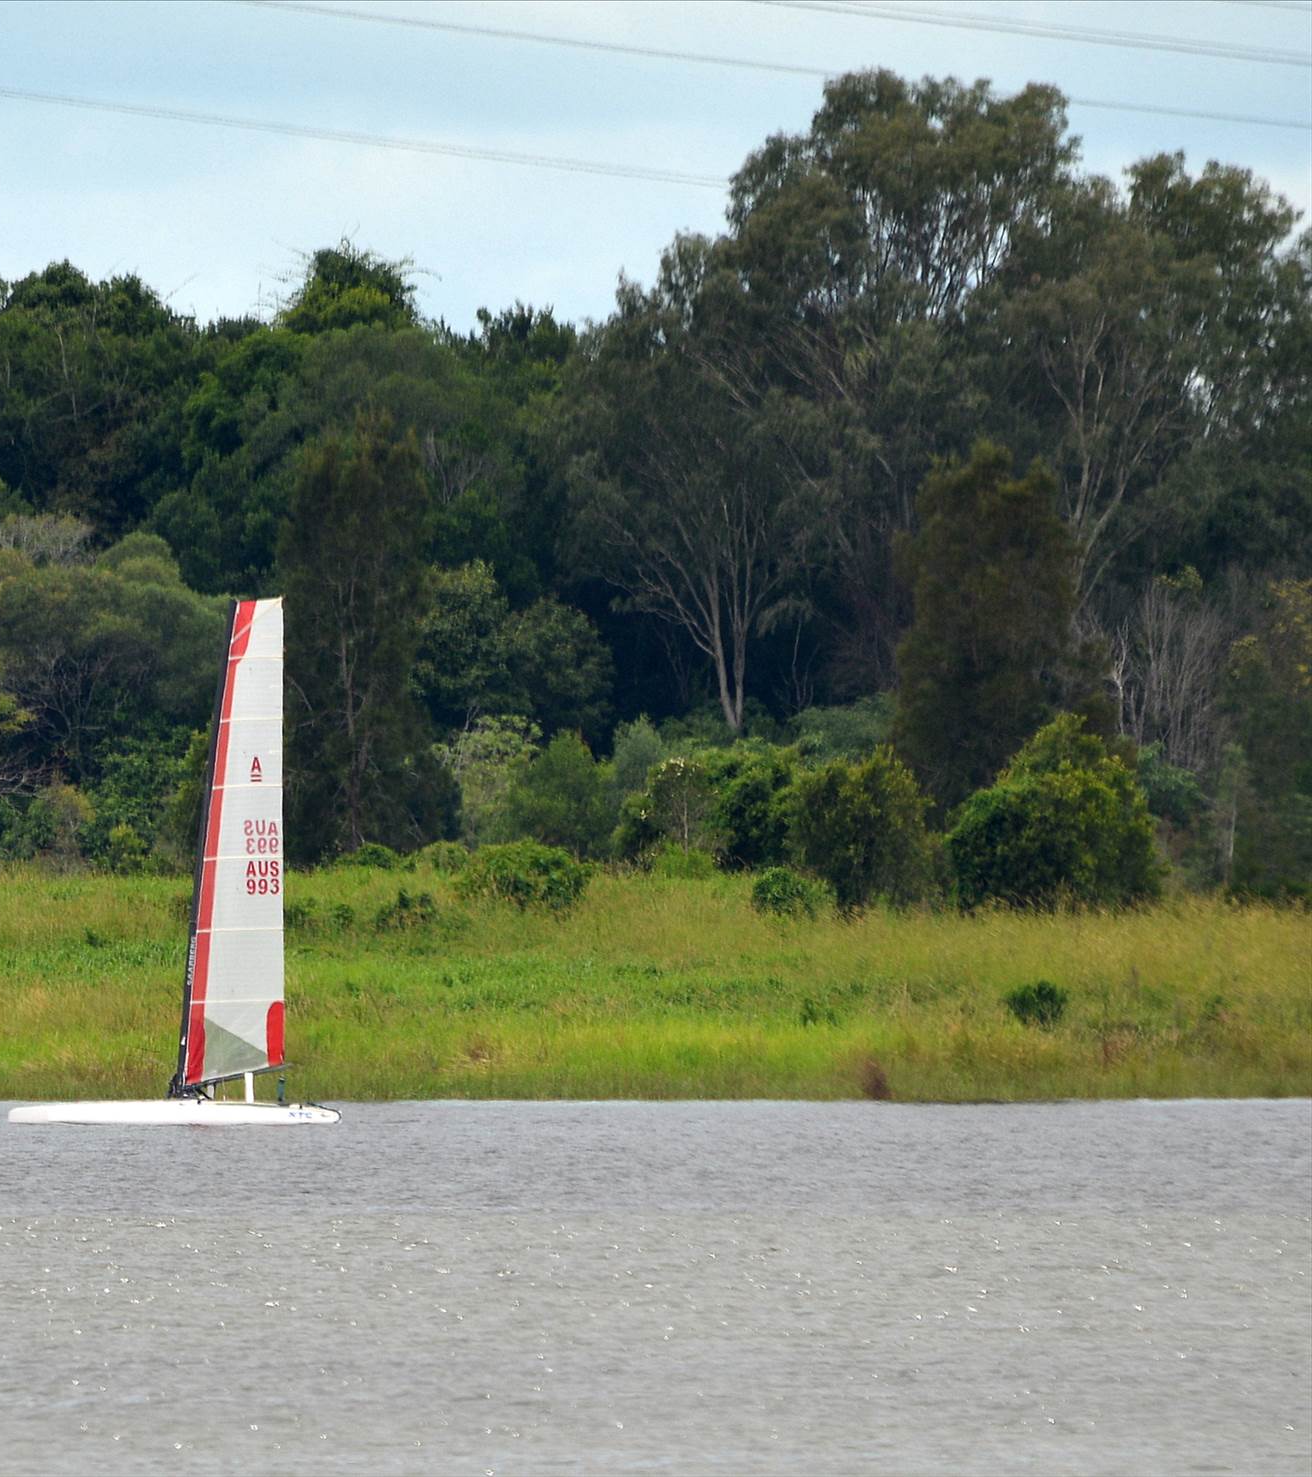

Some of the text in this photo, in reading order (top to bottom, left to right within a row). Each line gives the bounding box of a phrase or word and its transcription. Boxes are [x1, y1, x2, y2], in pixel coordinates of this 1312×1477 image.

[251, 756, 261, 773] A
[246, 860, 279, 877] AUS
[246, 878, 280, 895] 993
